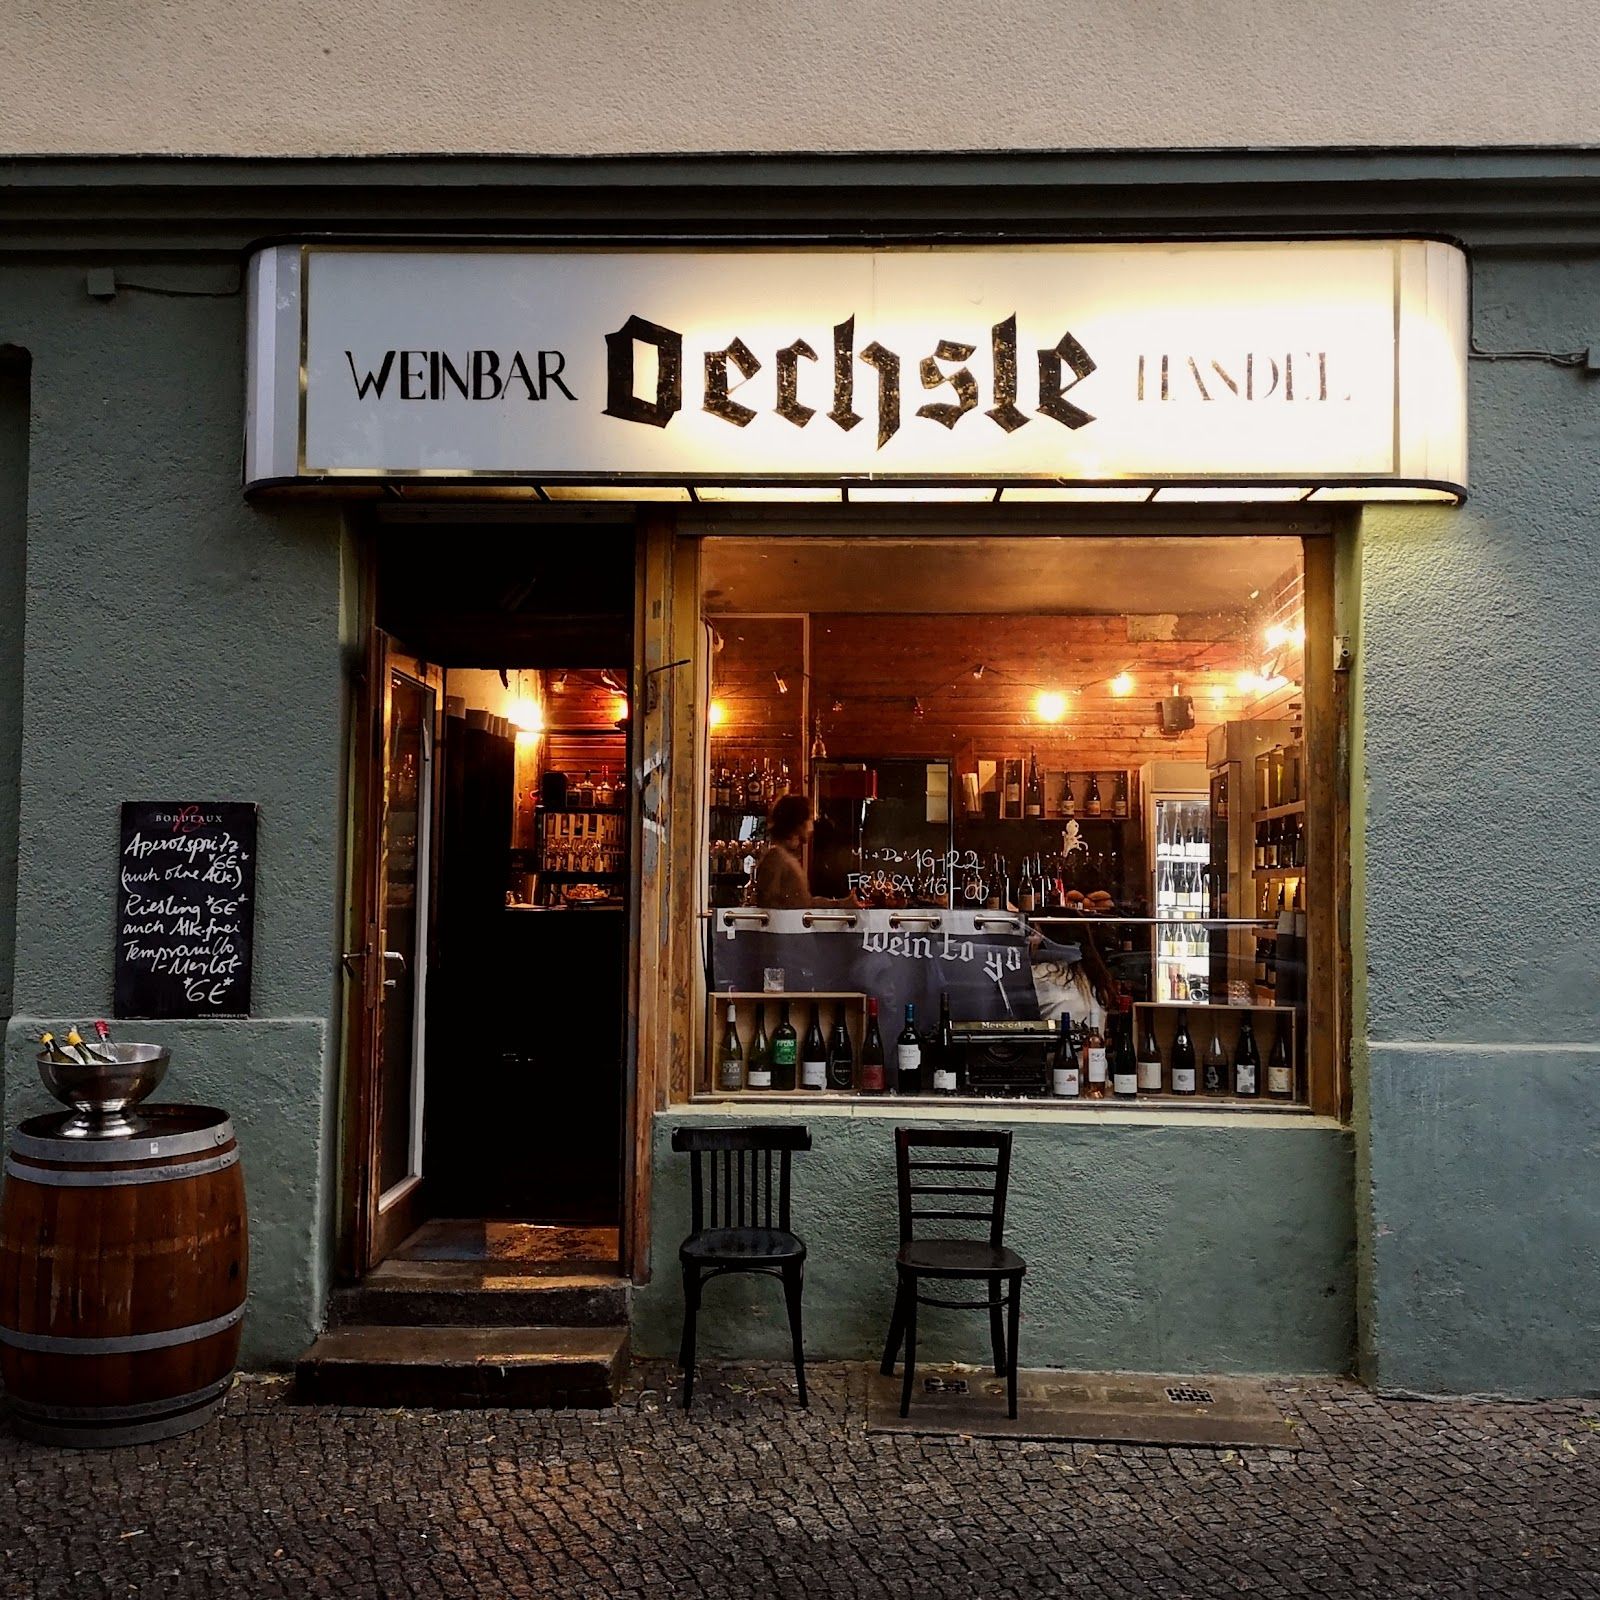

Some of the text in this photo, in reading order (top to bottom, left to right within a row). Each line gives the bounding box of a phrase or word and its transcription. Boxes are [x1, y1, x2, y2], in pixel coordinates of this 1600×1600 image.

[345, 350, 578, 401] WEINBAR
[601, 312, 1097, 451] Oechsle
[155, 815, 223, 823] BORDEAUX
[164, 864, 200, 880] ohne
[124, 894, 201, 926] Riesling
[123, 920, 164, 934] auch
[862, 928, 934, 959] Wein
[938, 932, 975, 962] to
